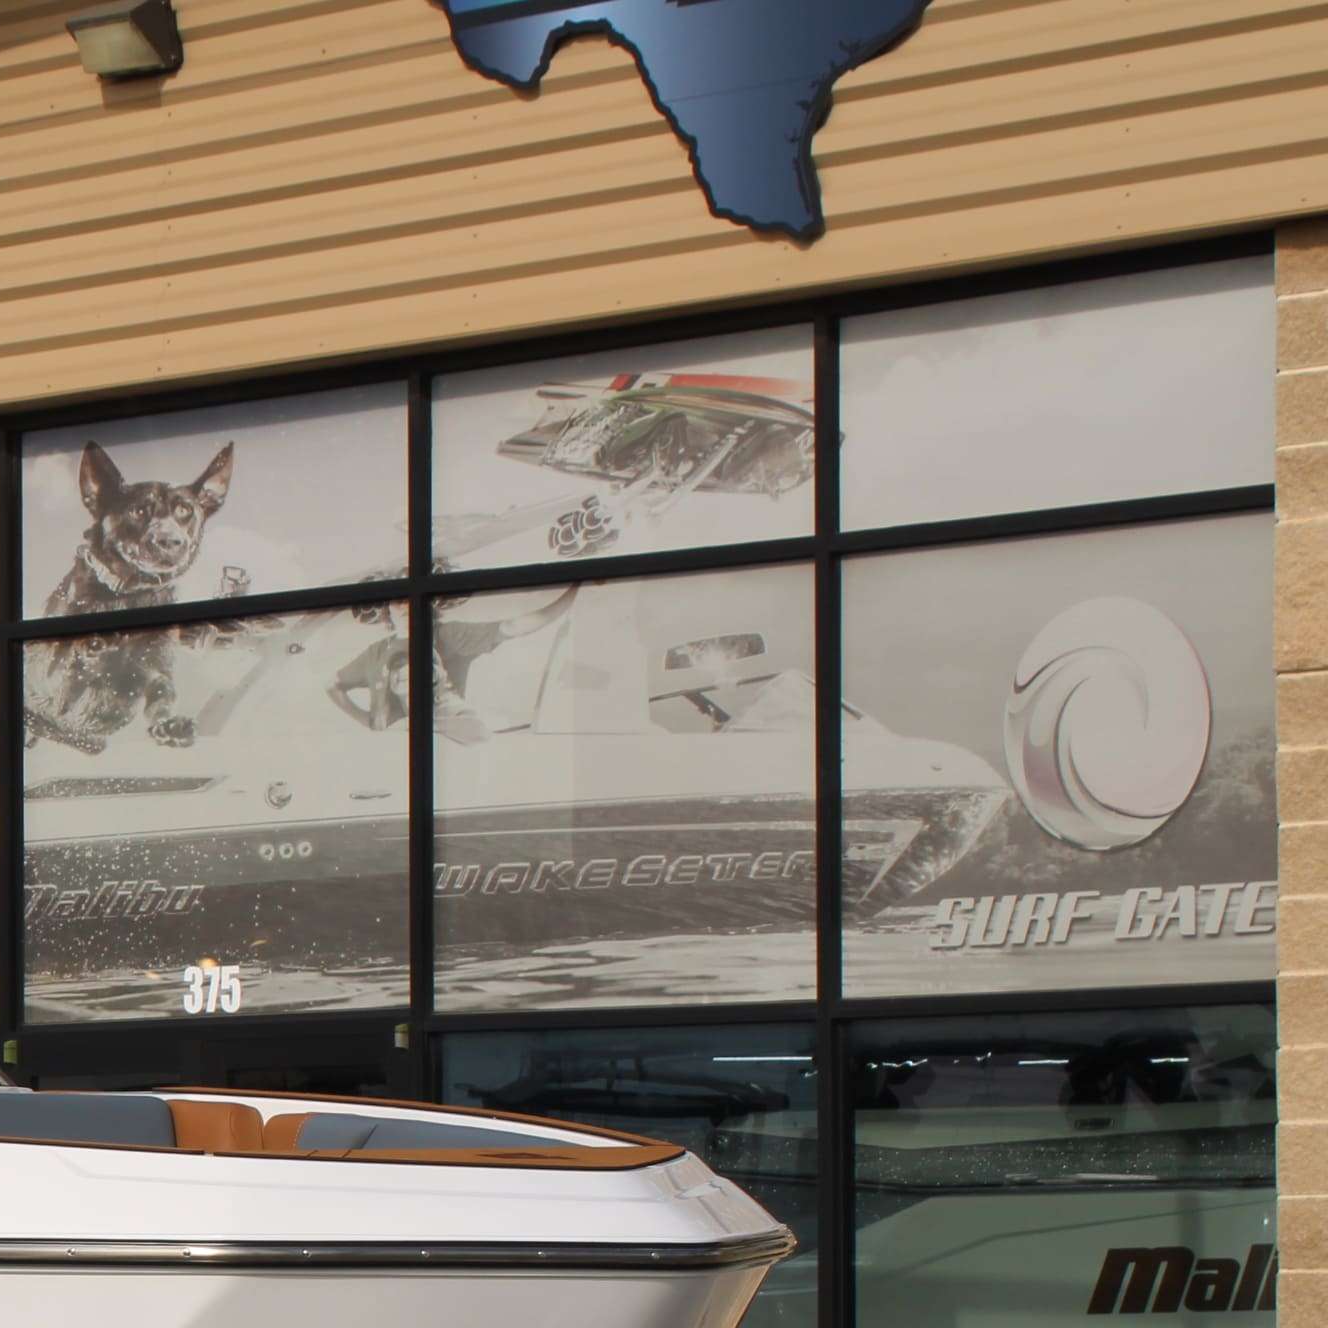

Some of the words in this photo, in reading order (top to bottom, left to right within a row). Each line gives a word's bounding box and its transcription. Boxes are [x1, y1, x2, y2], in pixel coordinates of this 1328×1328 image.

[929, 890, 1100, 950] SURF
[1114, 880, 1279, 942] GATE
[182, 964, 242, 1014] 375
